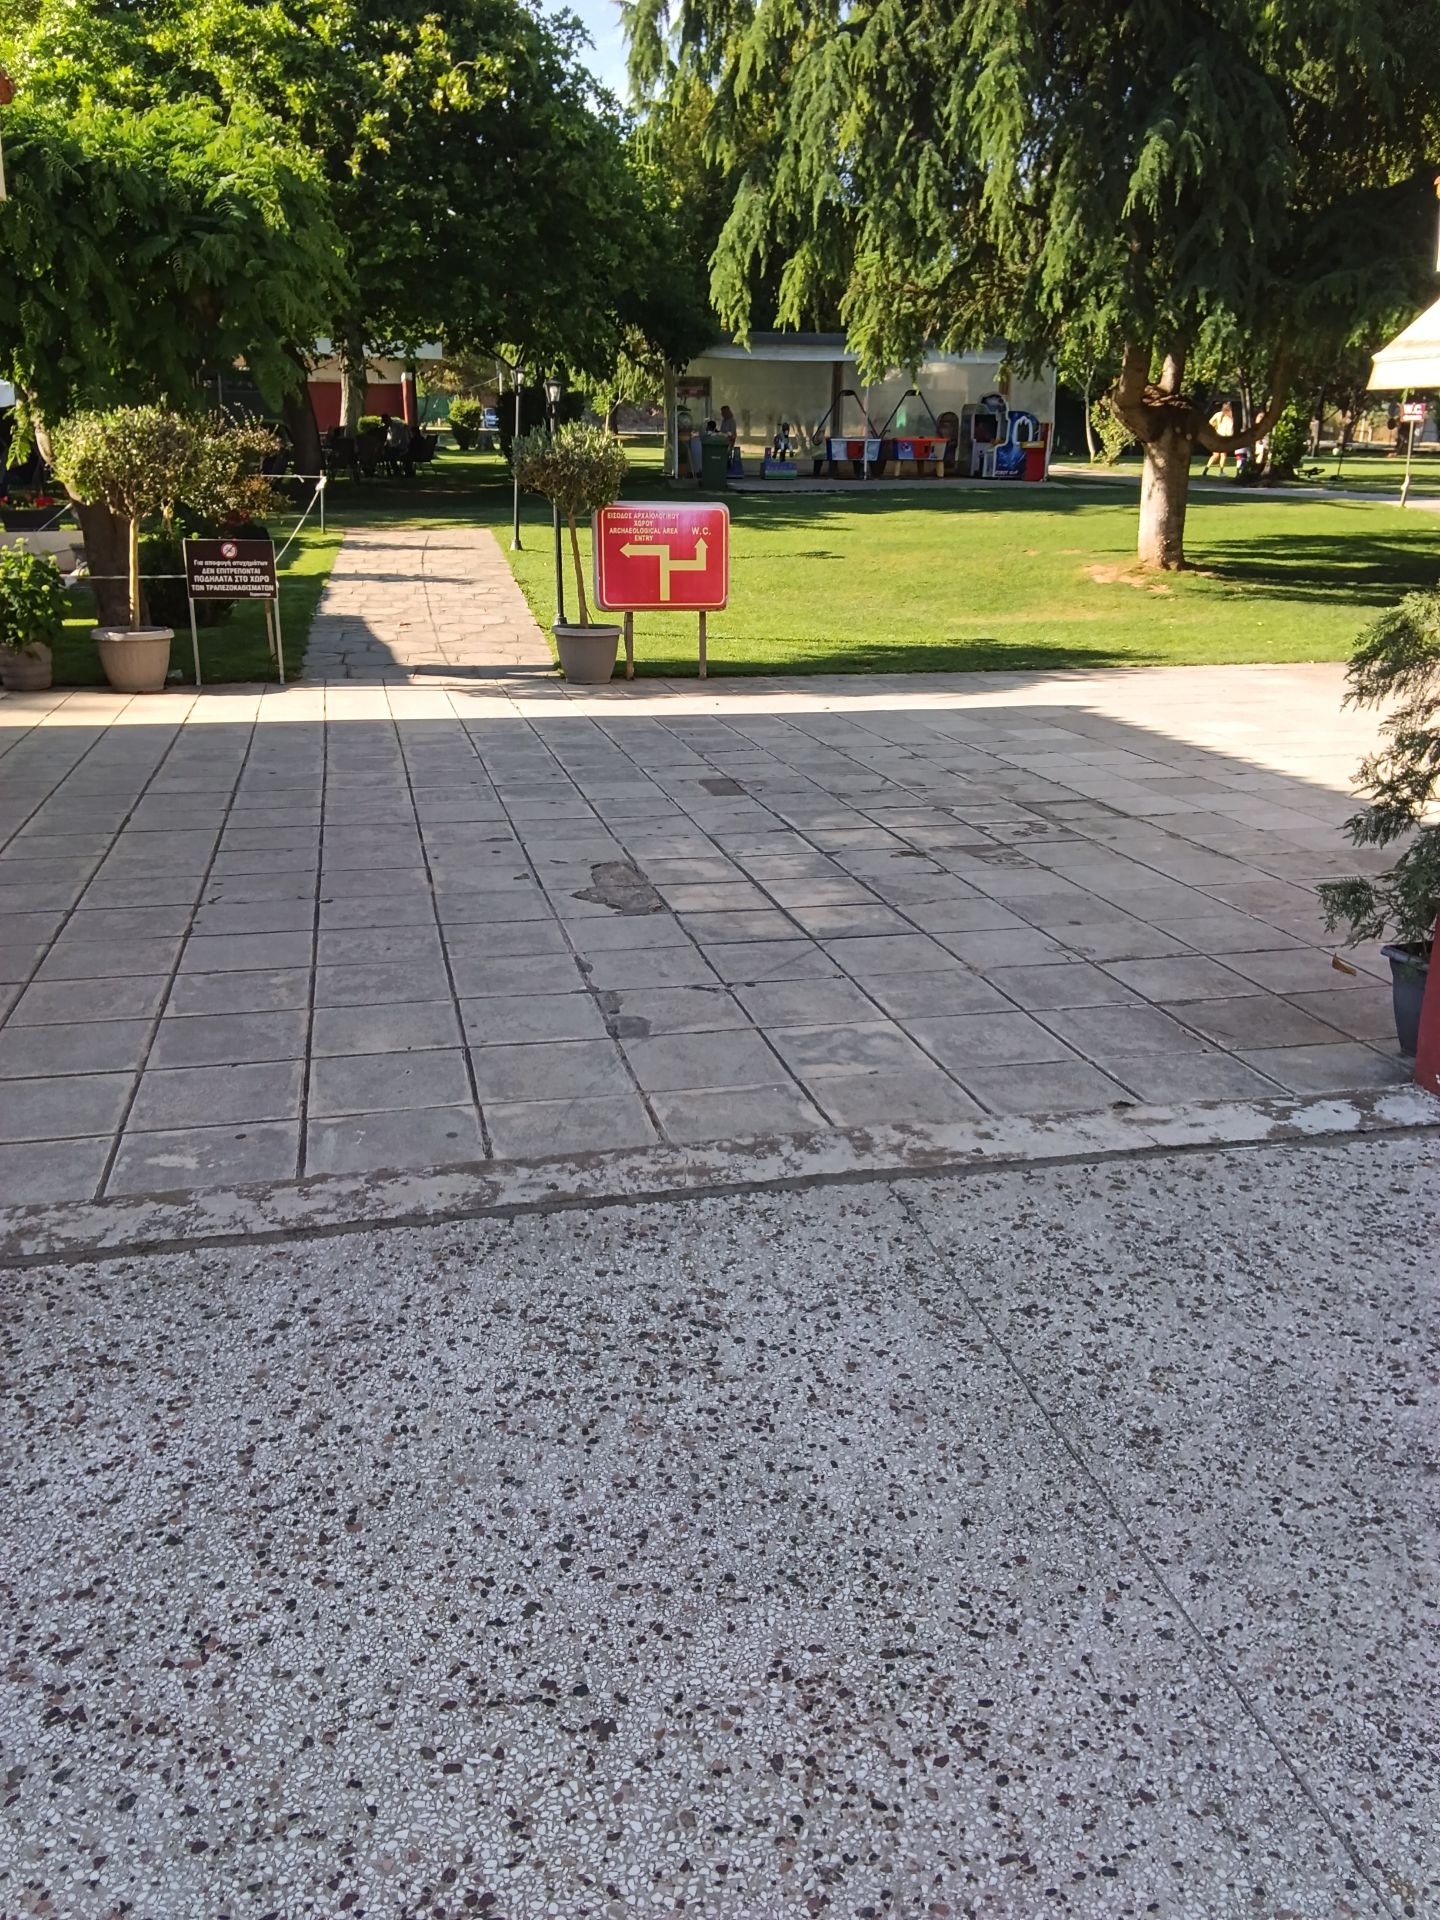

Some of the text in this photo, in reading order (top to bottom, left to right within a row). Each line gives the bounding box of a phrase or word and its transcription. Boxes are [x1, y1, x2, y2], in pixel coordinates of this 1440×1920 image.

[691, 527, 712, 536] W.C.
[194, 575, 270, 583] ΠΟΔΗΛΑΤΑ ΣΤΟ ΧΩΡΟ
